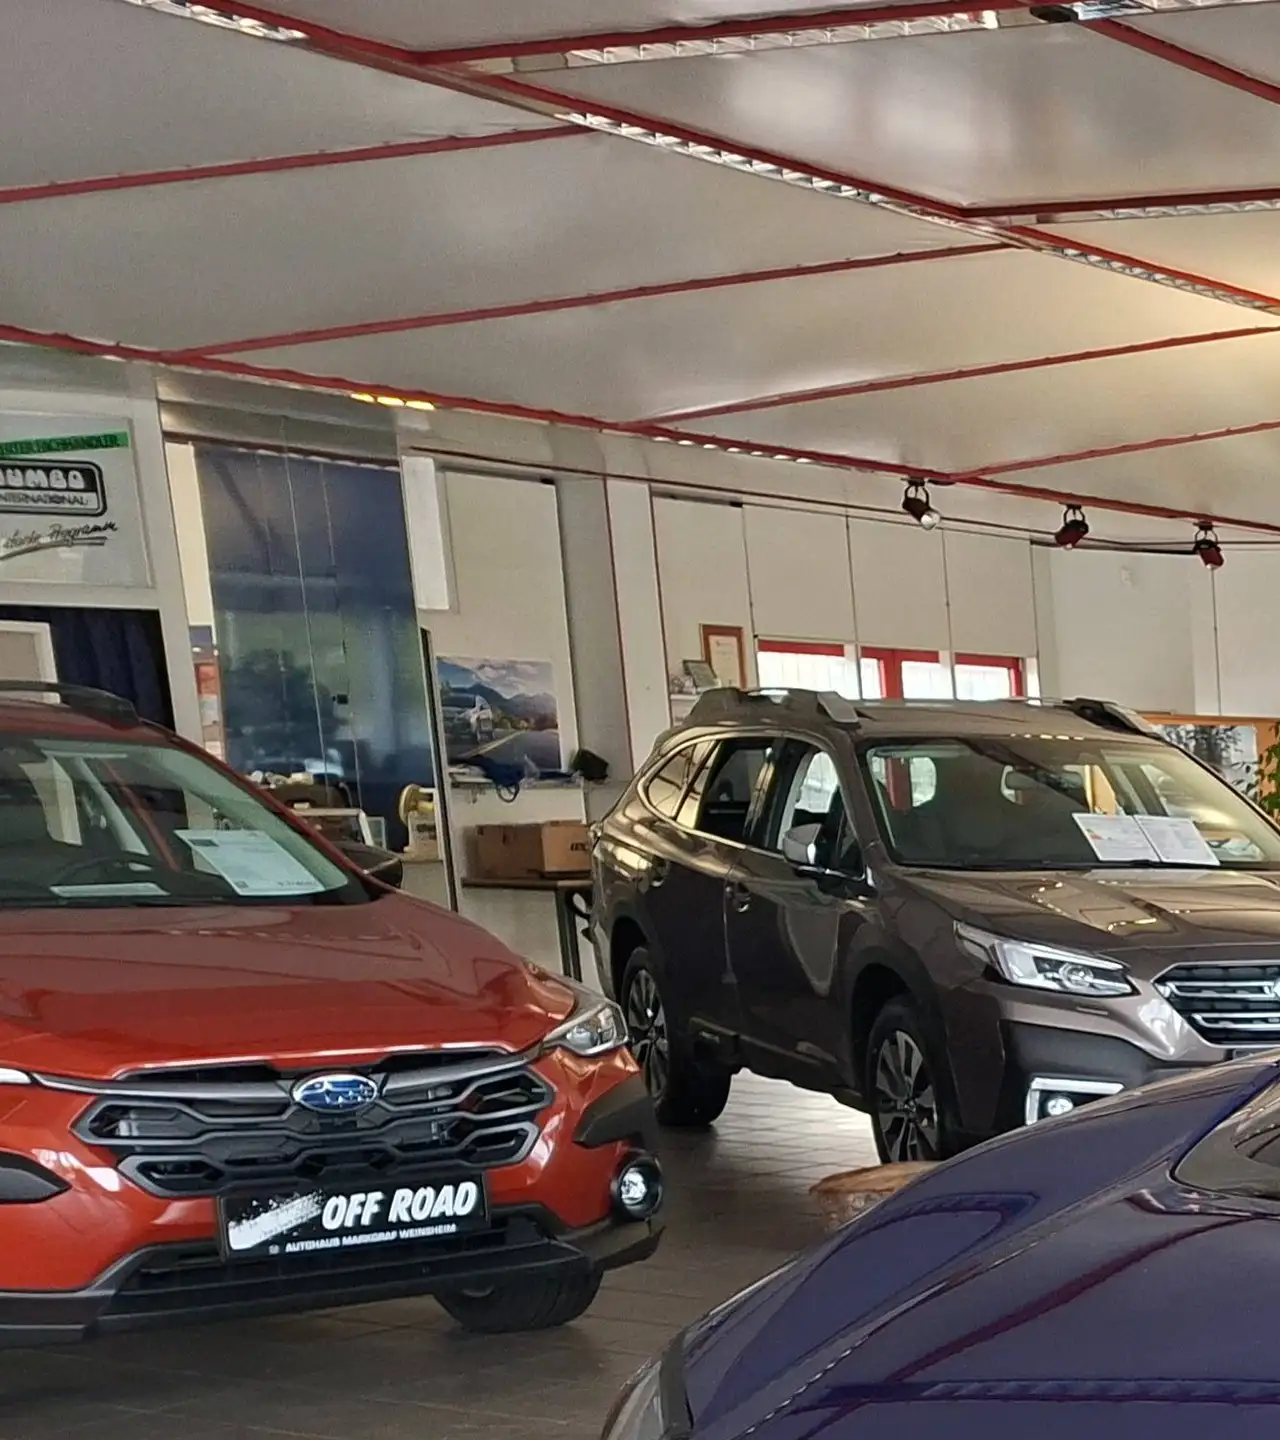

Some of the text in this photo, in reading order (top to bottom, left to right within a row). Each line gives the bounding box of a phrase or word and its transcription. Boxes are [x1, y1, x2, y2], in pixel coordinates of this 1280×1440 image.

[321, 1181, 478, 1231] OFF ROAD
[285, 1223, 458, 1254] AUTOHAUS MARKGRAF WEINSHEIM
